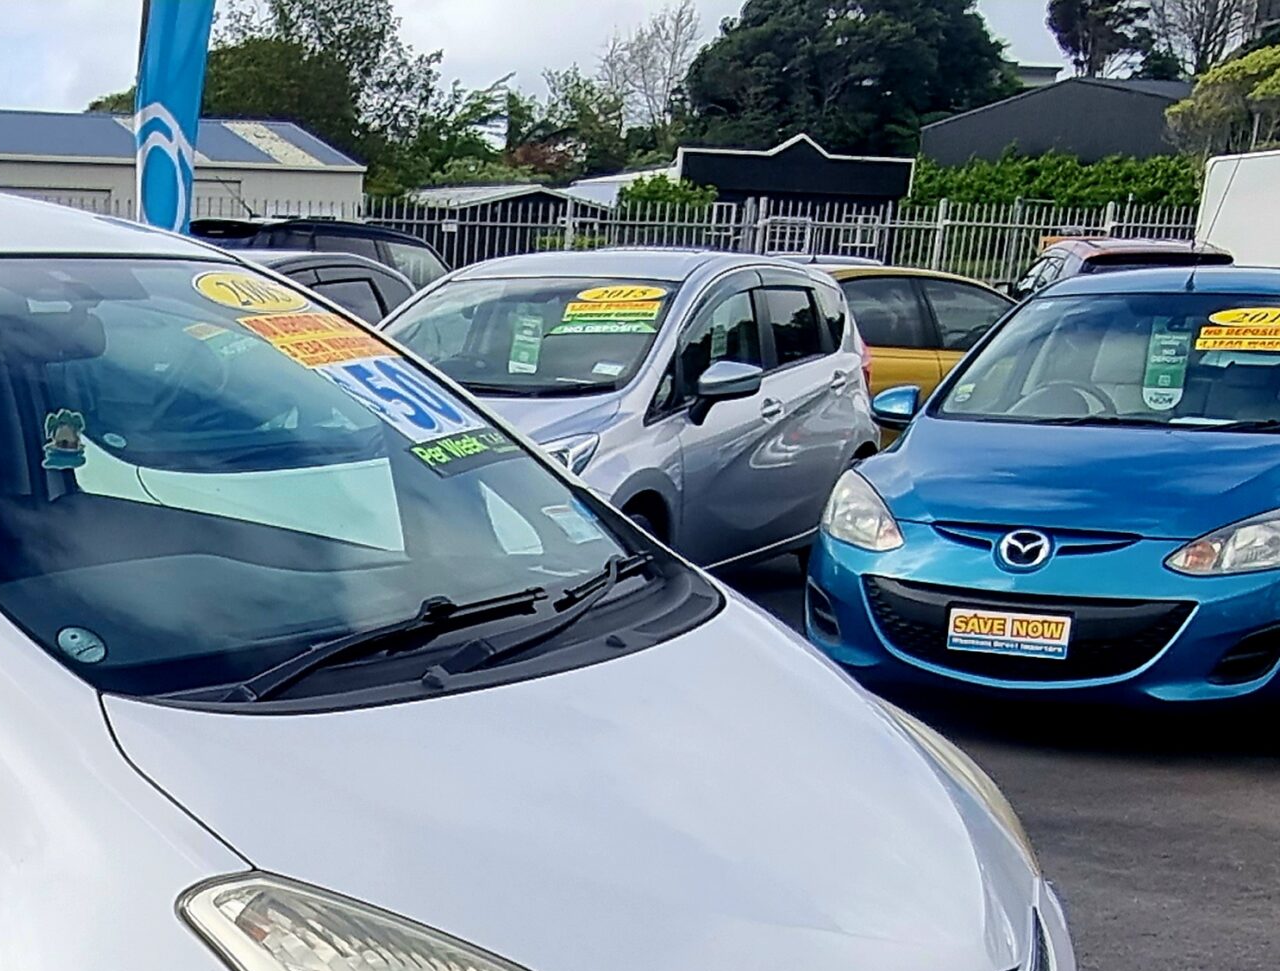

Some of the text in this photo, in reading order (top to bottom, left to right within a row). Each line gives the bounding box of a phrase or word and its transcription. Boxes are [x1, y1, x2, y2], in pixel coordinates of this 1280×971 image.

[410, 446, 452, 466] Per
[435, 434, 490, 458] Week
[953, 614, 1066, 641] SAVE NOW
